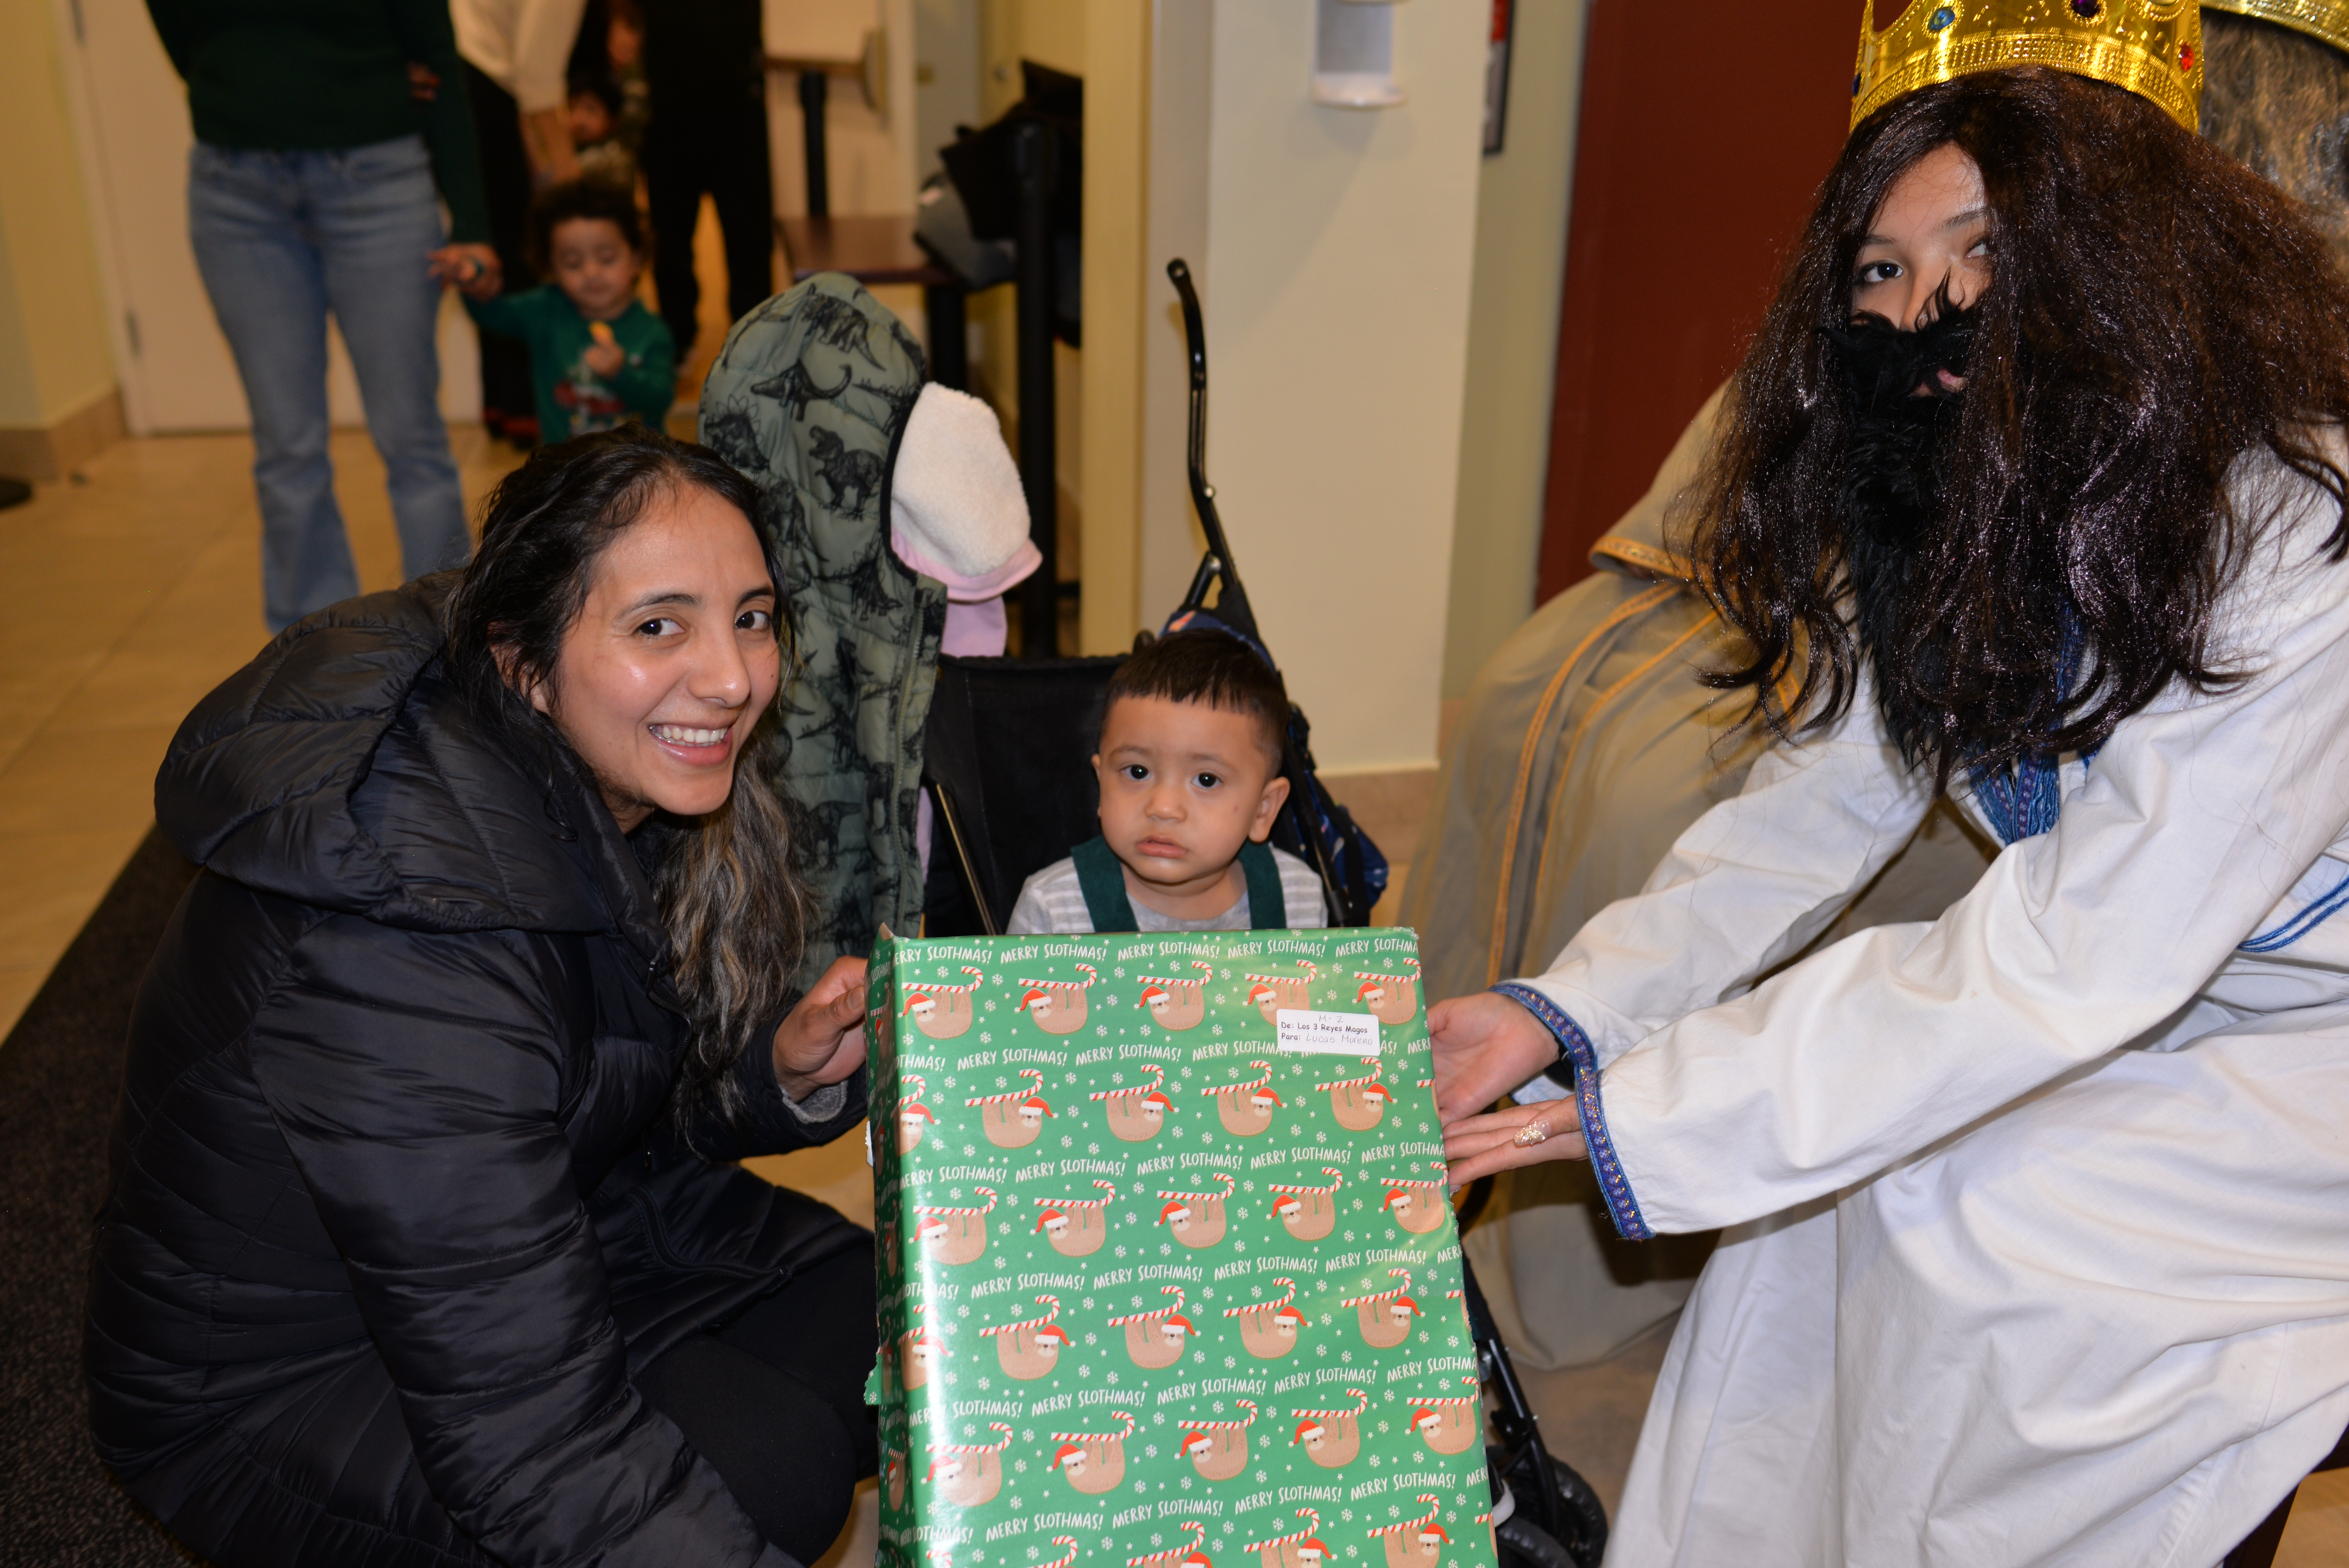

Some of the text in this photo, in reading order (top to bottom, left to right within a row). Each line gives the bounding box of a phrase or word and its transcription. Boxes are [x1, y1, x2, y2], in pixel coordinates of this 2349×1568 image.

[892, 946, 992, 965] ERRY SLOTHMAS!
[1000, 944, 1107, 964] MERRY SLOTHMAS!
[1117, 941, 1220, 961] MERRY SLOTHMAS!
[1228, 939, 1326, 959] MERRY SLOTHMAS!
[1335, 938, 1419, 958] MERRY SLOTHMA
[1281, 1021, 1294, 1029] De:
[1321, 1024, 1342, 1033] Reyes
[1345, 1026, 1368, 1035] Magos
[1281, 1032, 1373, 1045] Para: Lucas Moreno
[1076, 1044, 1181, 1066] MERRY SLOTHMAS!
[1192, 1043, 1228, 1062] MERRY
[1408, 1037, 1431, 1054] MERR
[894, 1054, 946, 1071] OTHMAS!
[957, 1048, 1068, 1071] MERRY SLOTHMAS!
[1251, 1147, 1351, 1170] MERRY SLOTHMAS!
[1362, 1142, 1445, 1164] MERRY SLOTHMA
[939, 1166, 1007, 1183] SLOTHMAS!
[1015, 1159, 1126, 1183] MERRY SLOTHMAS!
[1137, 1153, 1242, 1176] MERRY SLOTHMAS!
[1326, 1249, 1427, 1272] MERRY SLOTHMAS!
[1437, 1244, 1463, 1264] MERR
[1093, 1265, 1203, 1290] MERRY SLOTHMAS!
[1214, 1256, 1317, 1281] MERRY SLOTHMAS!
[971, 1273, 1085, 1299] MERRY SLOTHMAS!
[1387, 1356, 1477, 1383] MERRY SLOTHMA
[1157, 1378, 1266, 1405] MERRY SLOTHMAS!
[1274, 1368, 1376, 1394] MERRY SLOTHMAS!
[953, 1400, 1023, 1420] SLOTHMAS!
[1032, 1389, 1145, 1417] MERRY SLOTHMAS!
[1351, 1472, 1456, 1501] MERRY SLOTHMAS!
[1466, 1465, 1488, 1487] MERR
[1235, 1486, 1342, 1514] MERRY SLOTHMAS!
[1112, 1499, 1223, 1529] MERRY SLOTHMAS!
[913, 1526, 973, 1545] OTHMAS!
[986, 1513, 1103, 1542] MERRY SLOTHMAS!
